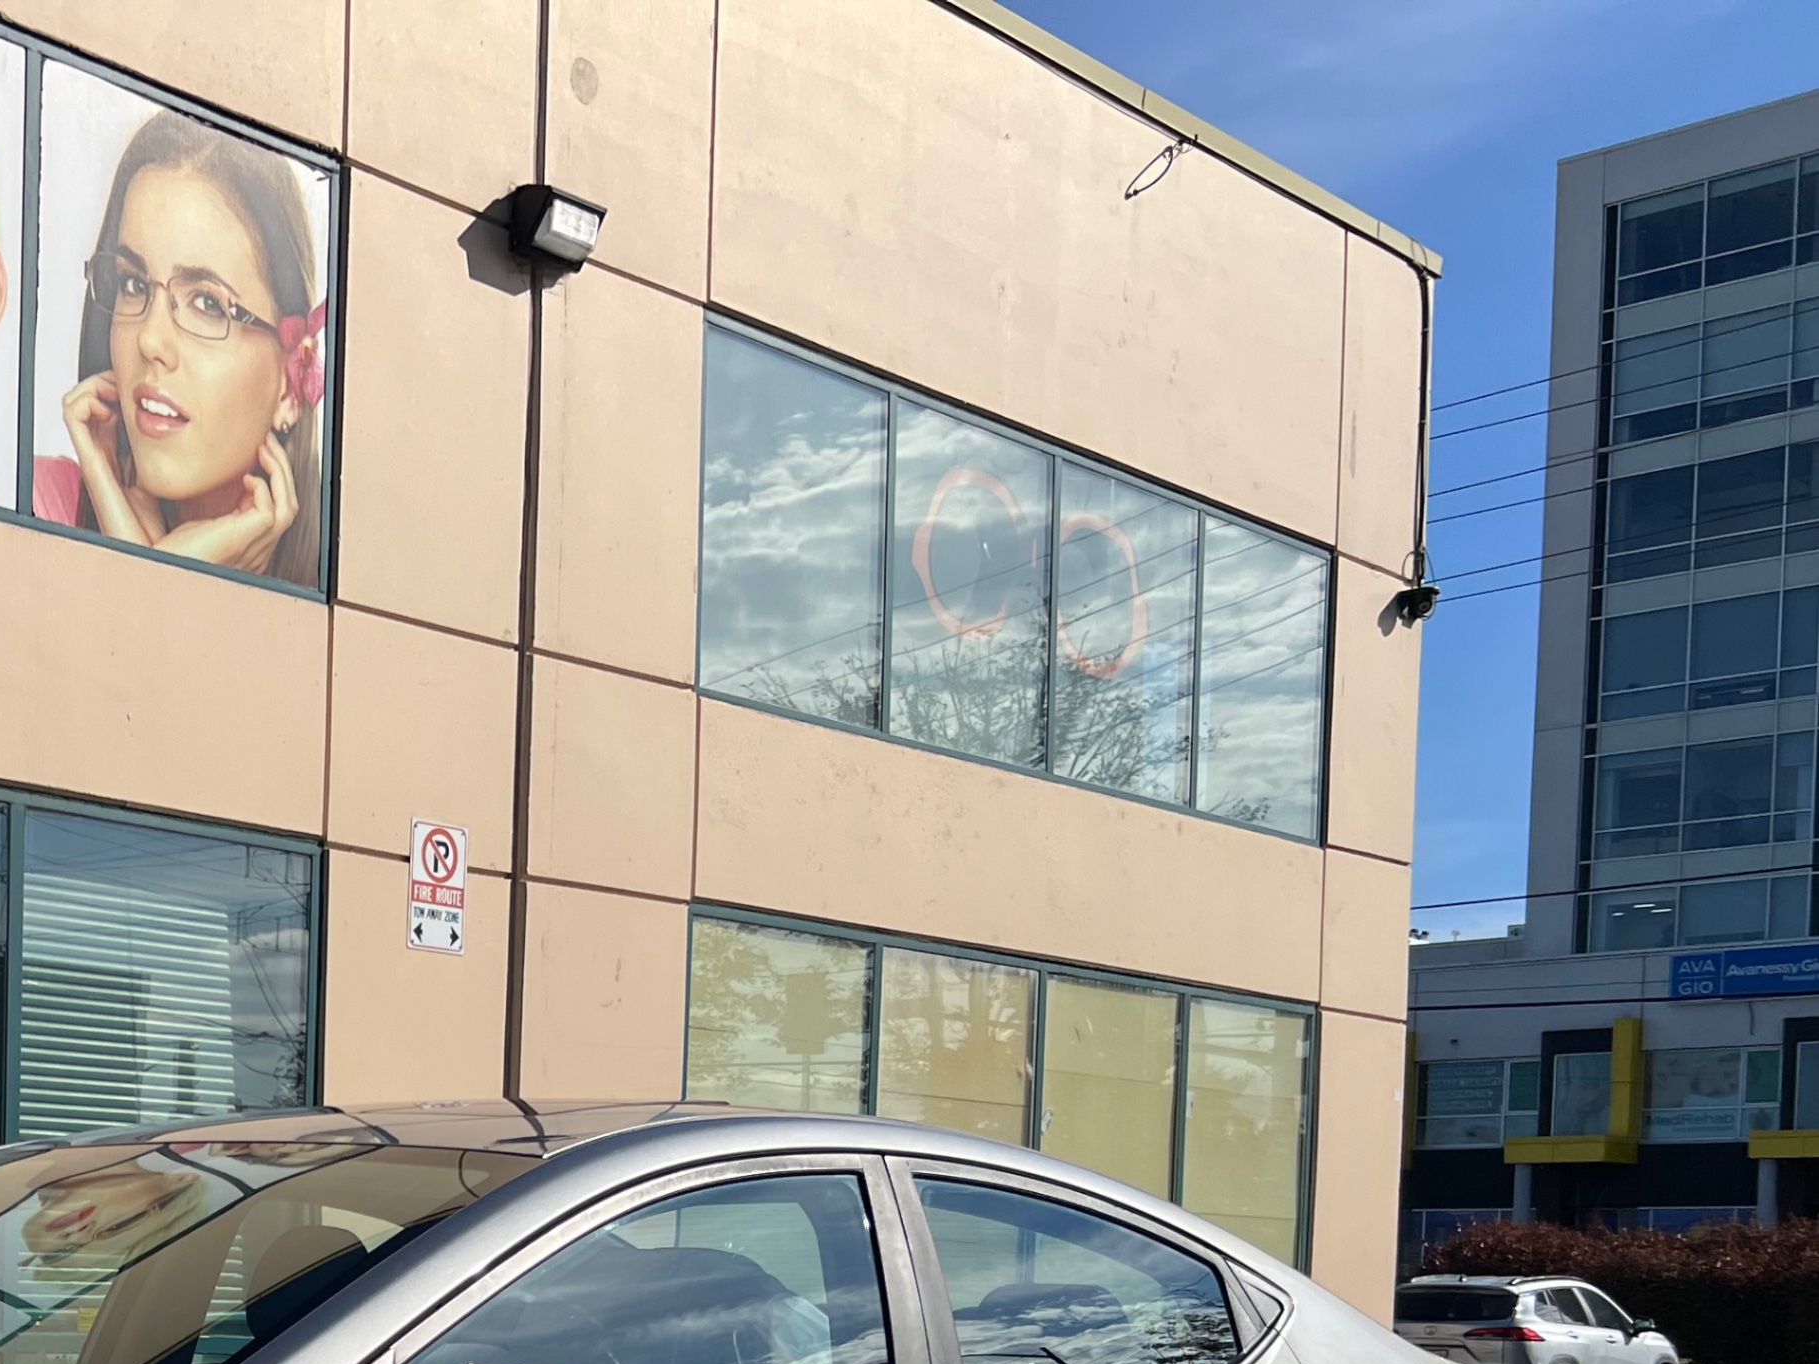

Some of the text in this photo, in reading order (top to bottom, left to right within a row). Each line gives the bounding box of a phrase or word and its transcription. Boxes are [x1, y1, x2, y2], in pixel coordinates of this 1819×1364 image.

[414, 884, 462, 907] FIRE ROUTE
[413, 906, 460, 924] TOW AWAY ZONE
[1678, 959, 1716, 974] AVA
[1678, 981, 1714, 996] GIO
